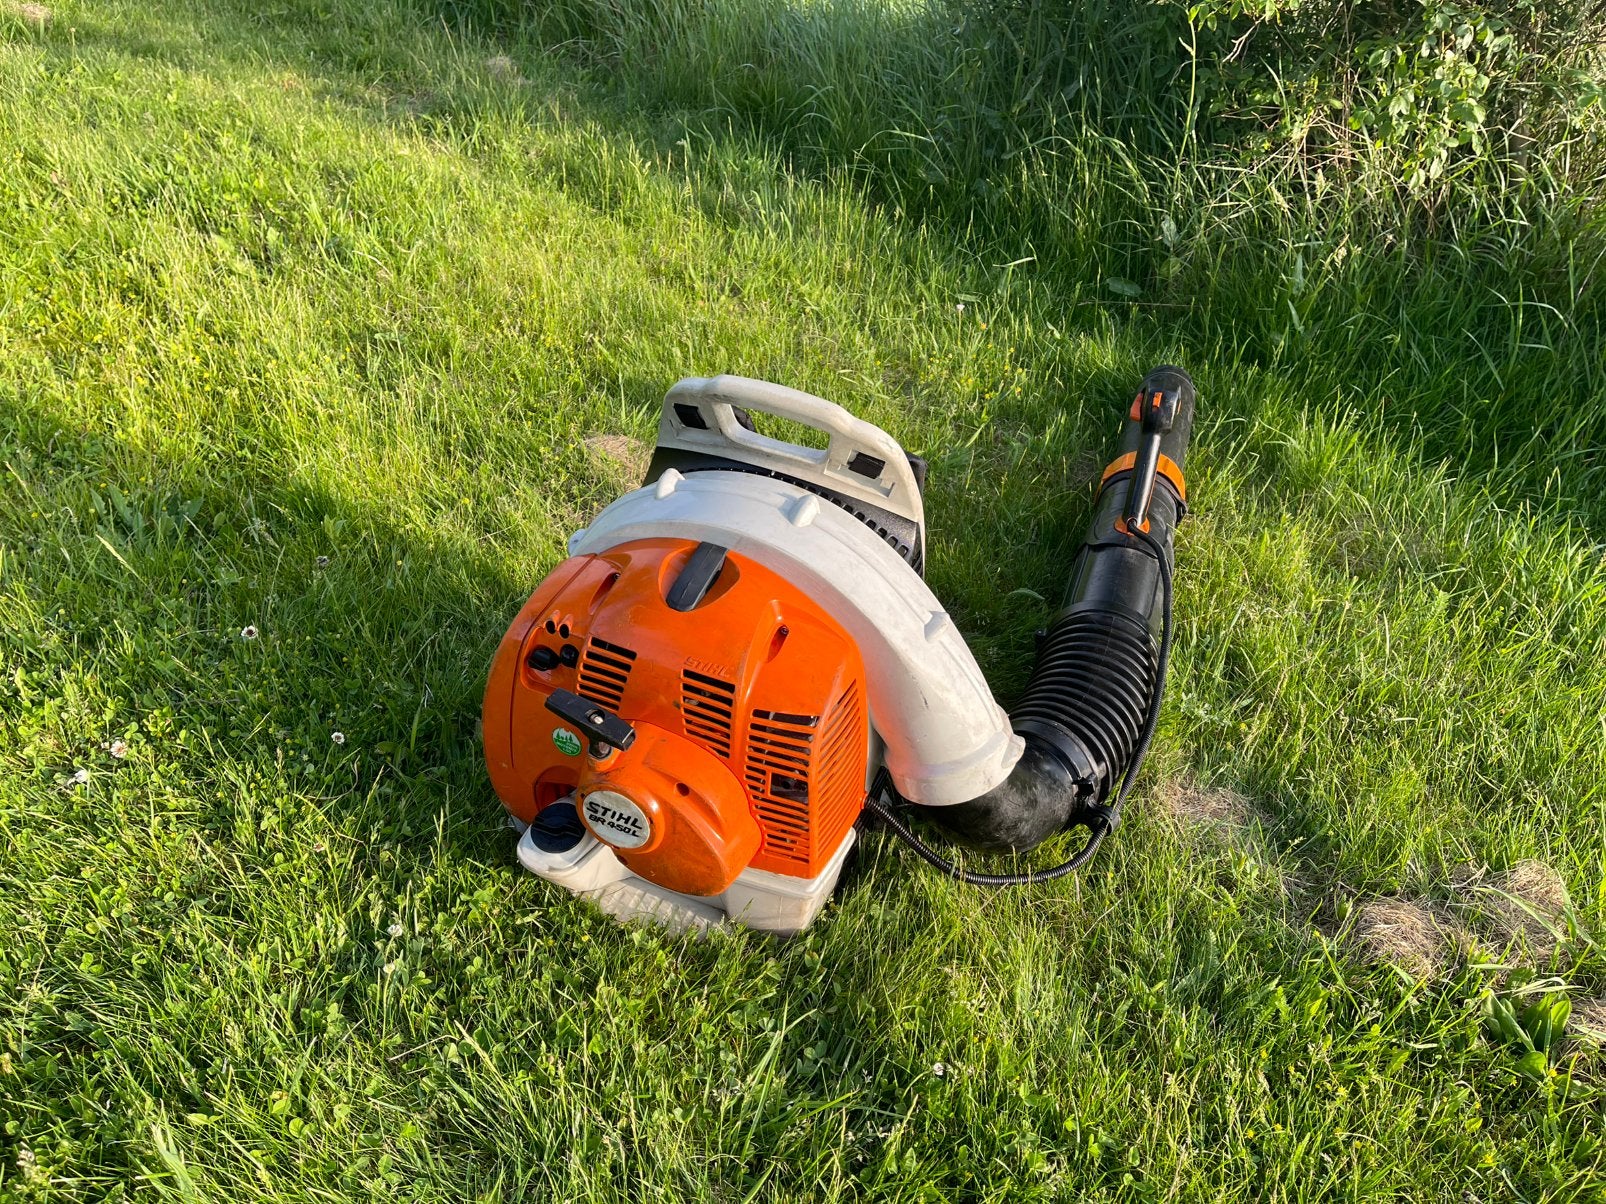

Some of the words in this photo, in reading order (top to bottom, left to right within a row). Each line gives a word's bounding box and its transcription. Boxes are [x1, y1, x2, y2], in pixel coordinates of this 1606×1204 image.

[683, 656, 730, 677] STIHL
[586, 801, 643, 830] STIHL
[588, 813, 606, 826] BR
